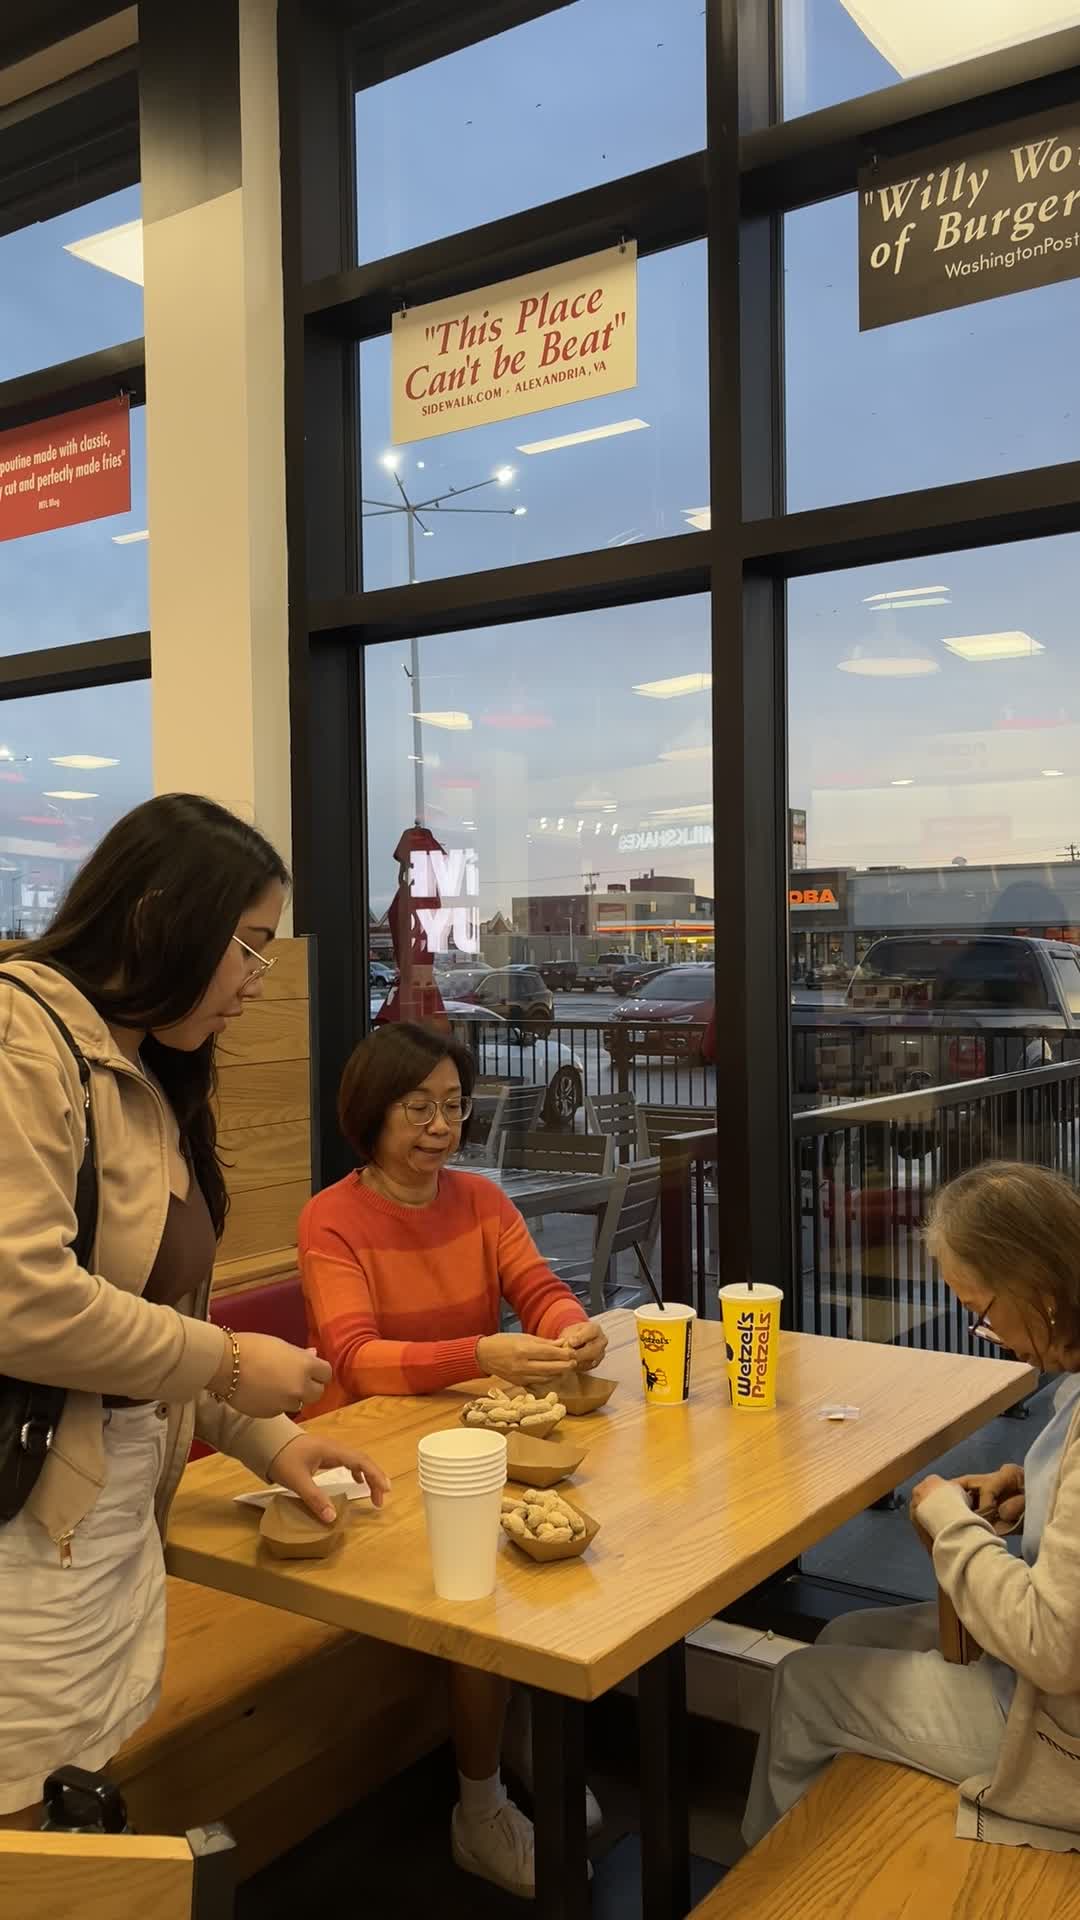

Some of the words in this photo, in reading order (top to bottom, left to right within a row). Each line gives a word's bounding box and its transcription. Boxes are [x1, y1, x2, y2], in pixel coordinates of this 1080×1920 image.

[864, 162, 990, 222] "Willy
[1010, 137, 1080, 183] Wo
[870, 222, 917, 275] of
[945, 232, 1080, 279] WashingtonPost
[425, 310, 503, 355] "This
[515, 288, 603, 336] Place
[405, 355, 481, 400] Can't
[493, 344, 526, 380] be
[538, 312, 626, 368] Beat"
[421, 388, 502, 416] SIDEWALK.COM
[514, 366, 592, 393] ALEXANDRIA,
[593, 360, 607, 372] VA
[0, 454, 32, 477] poutine
[33, 444, 57, 465] made
[59, 438, 78, 458] with
[80, 432, 111, 453] classic,
[4, 480, 18, 496] cut
[19, 472, 35, 492] and
[37, 464, 74, 491] perfectly
[76, 456, 100, 477] made
[102, 449, 126, 471] fries"
[737, 1312, 754, 1396] Wetzel's
[751, 1312, 771, 1398] Pretzels
